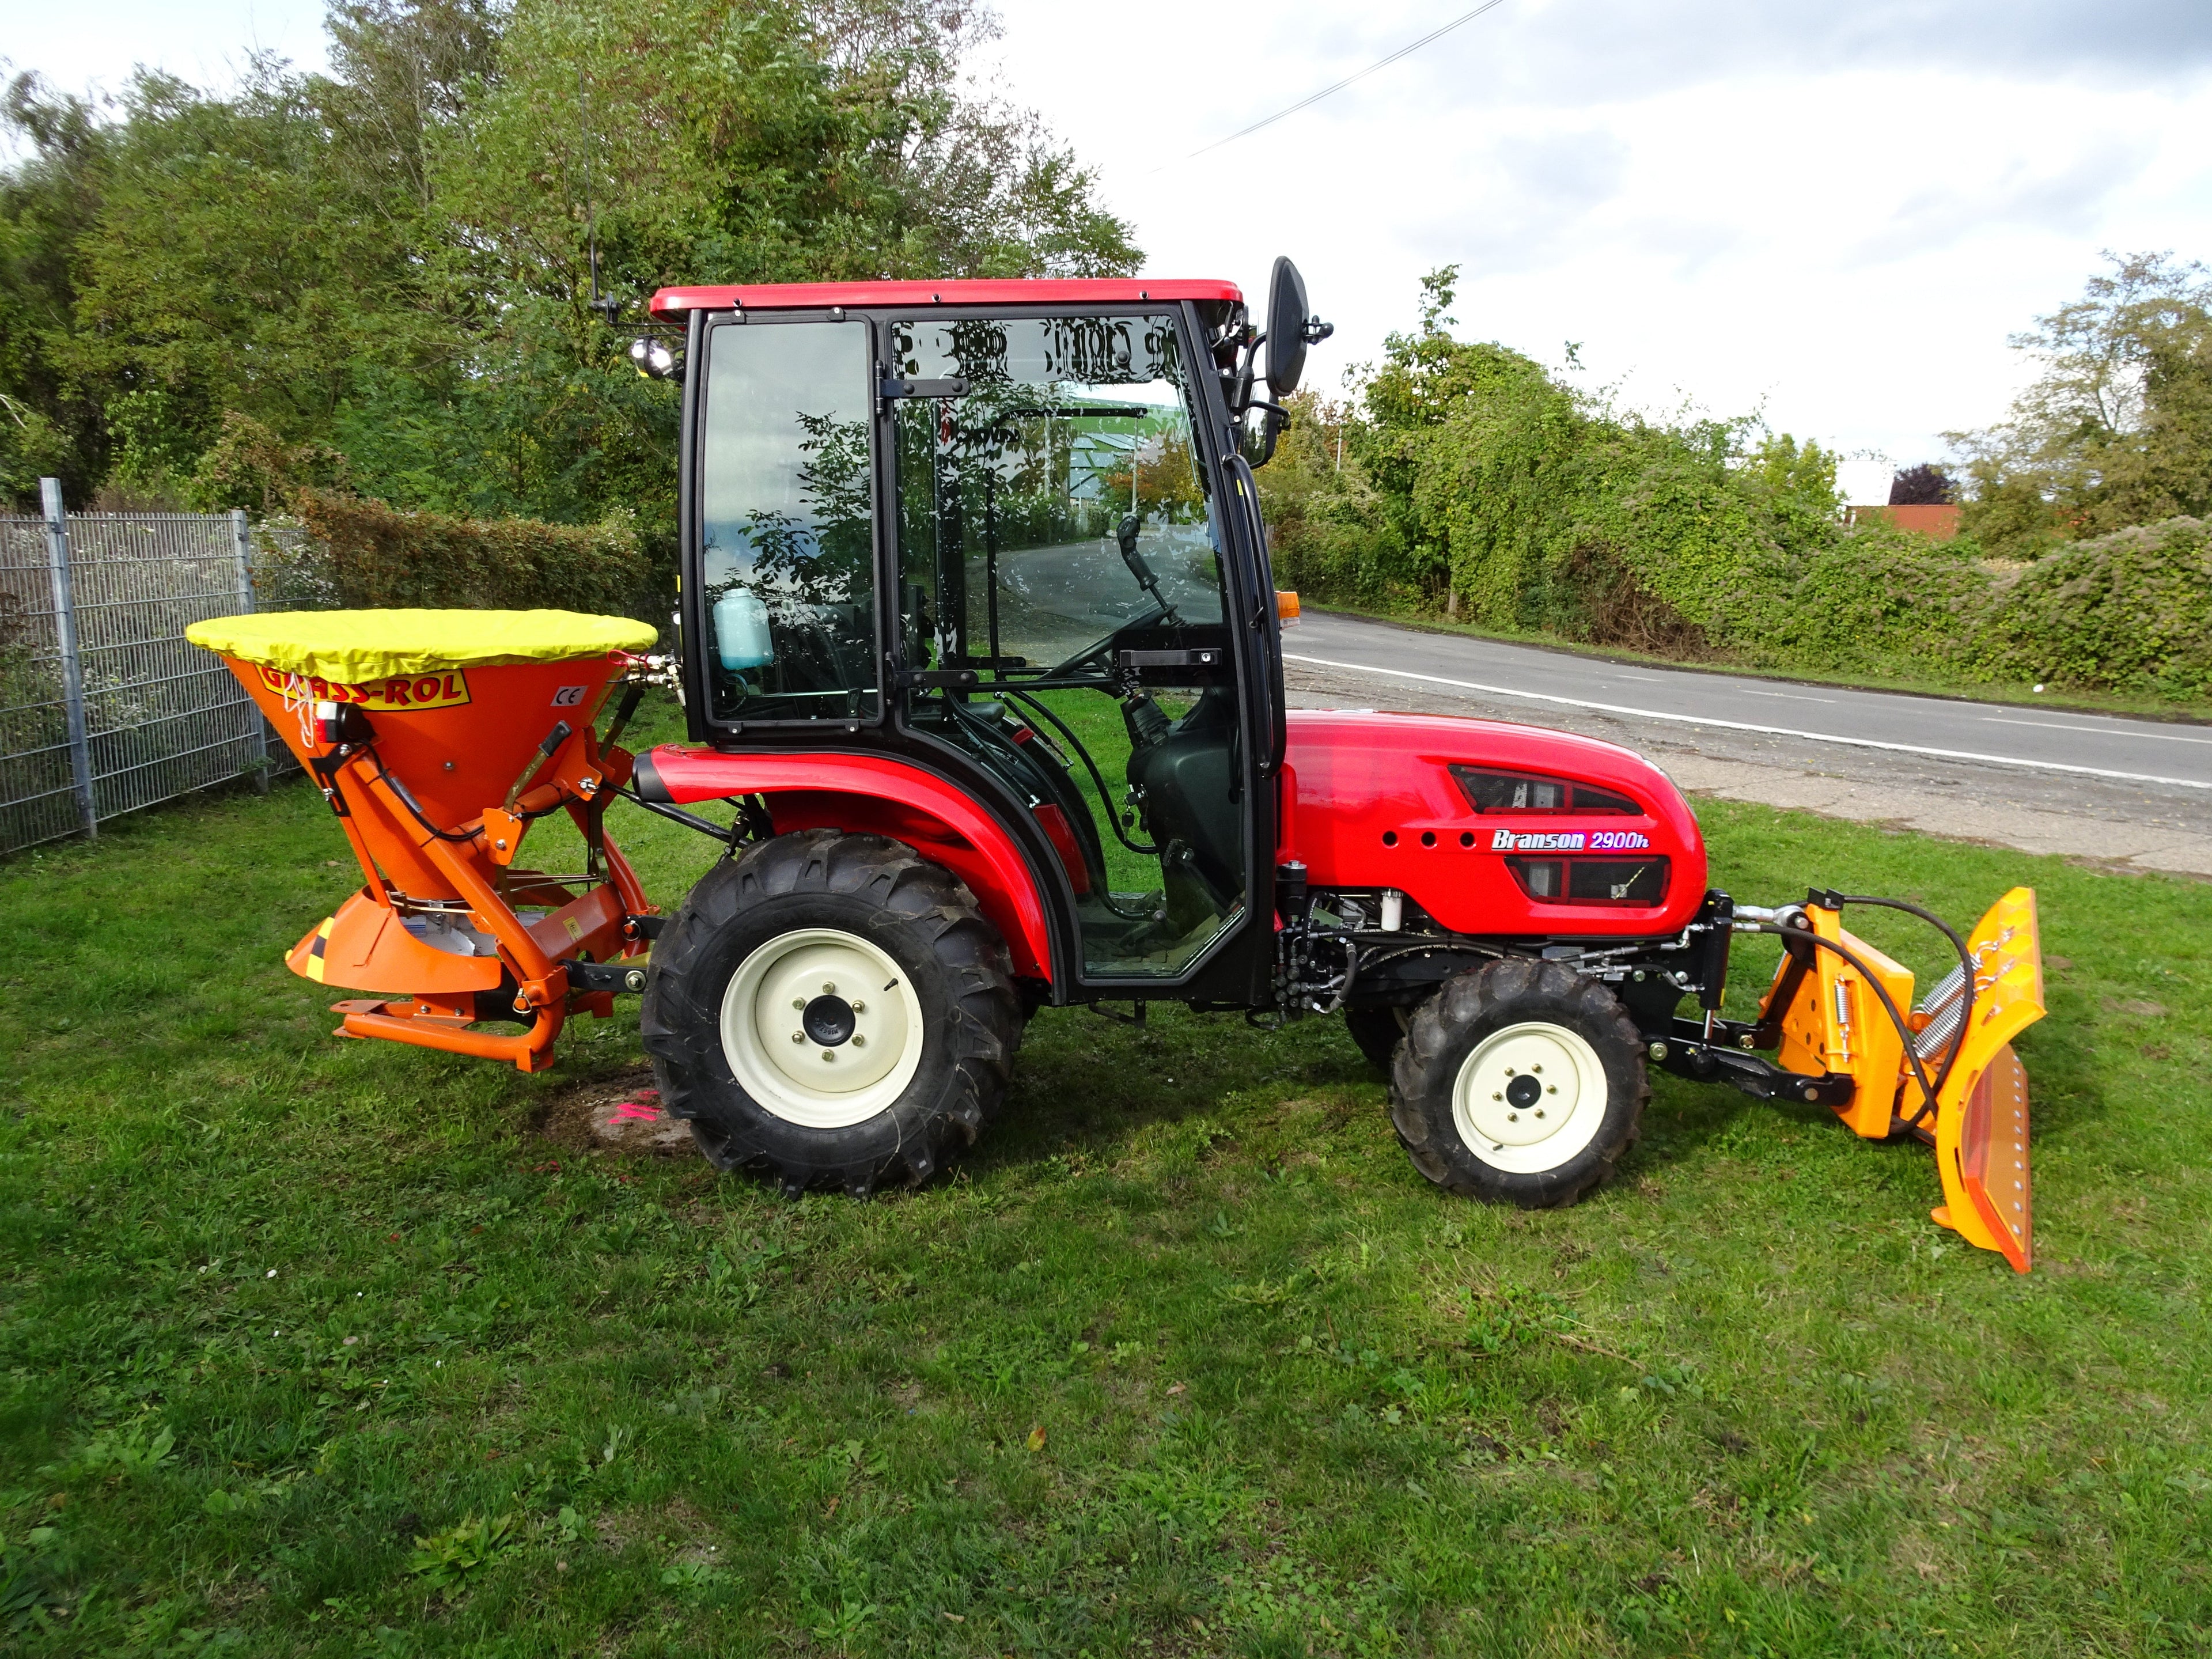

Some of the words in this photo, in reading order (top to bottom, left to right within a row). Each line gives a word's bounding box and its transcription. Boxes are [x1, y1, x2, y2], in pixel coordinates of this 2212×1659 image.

[261, 665, 462, 706] GRASS-ROL
[556, 688, 581, 704] CE
[1491, 829, 1585, 851] Branson
[1589, 831, 1650, 849] 2900h
